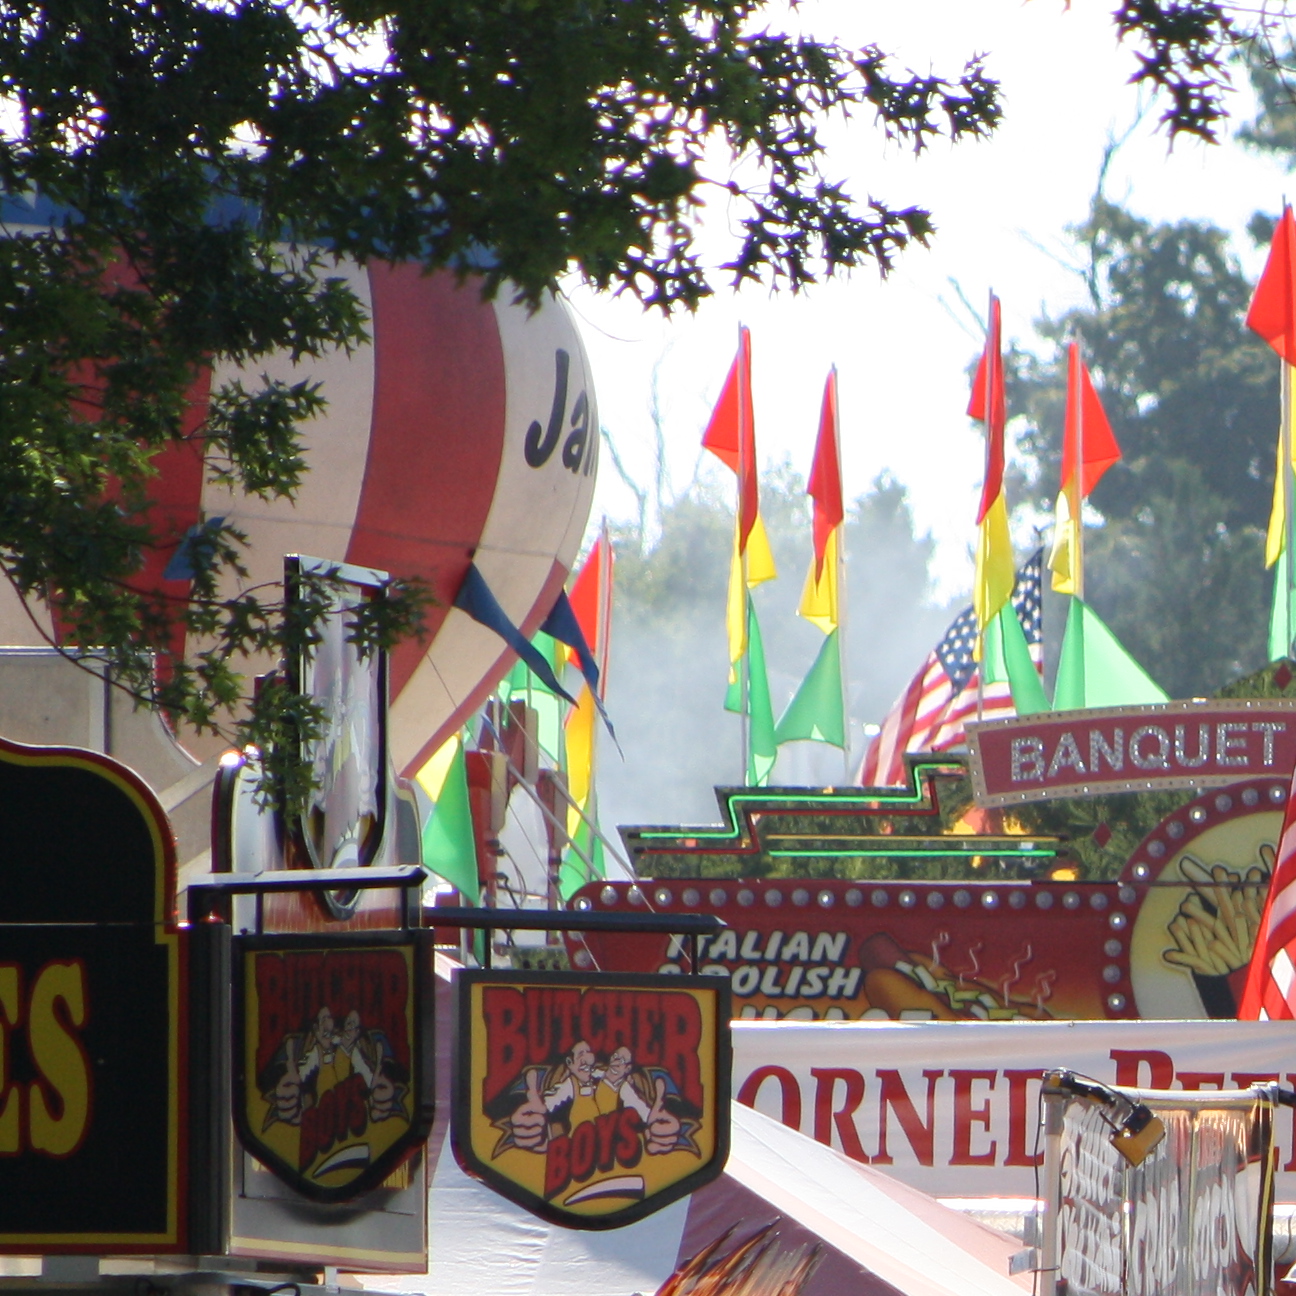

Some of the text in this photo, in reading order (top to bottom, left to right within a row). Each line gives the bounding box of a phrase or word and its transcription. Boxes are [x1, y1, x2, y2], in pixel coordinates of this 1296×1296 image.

[1010, 721, 1287, 783] BANQUET
[666, 929, 851, 964] ITALIAN
[700, 963, 863, 999] OLISH
[254, 950, 411, 1080] BUTCHER
[482, 985, 704, 1110] BUTCHER
[544, 1106, 642, 1199] BOYS
